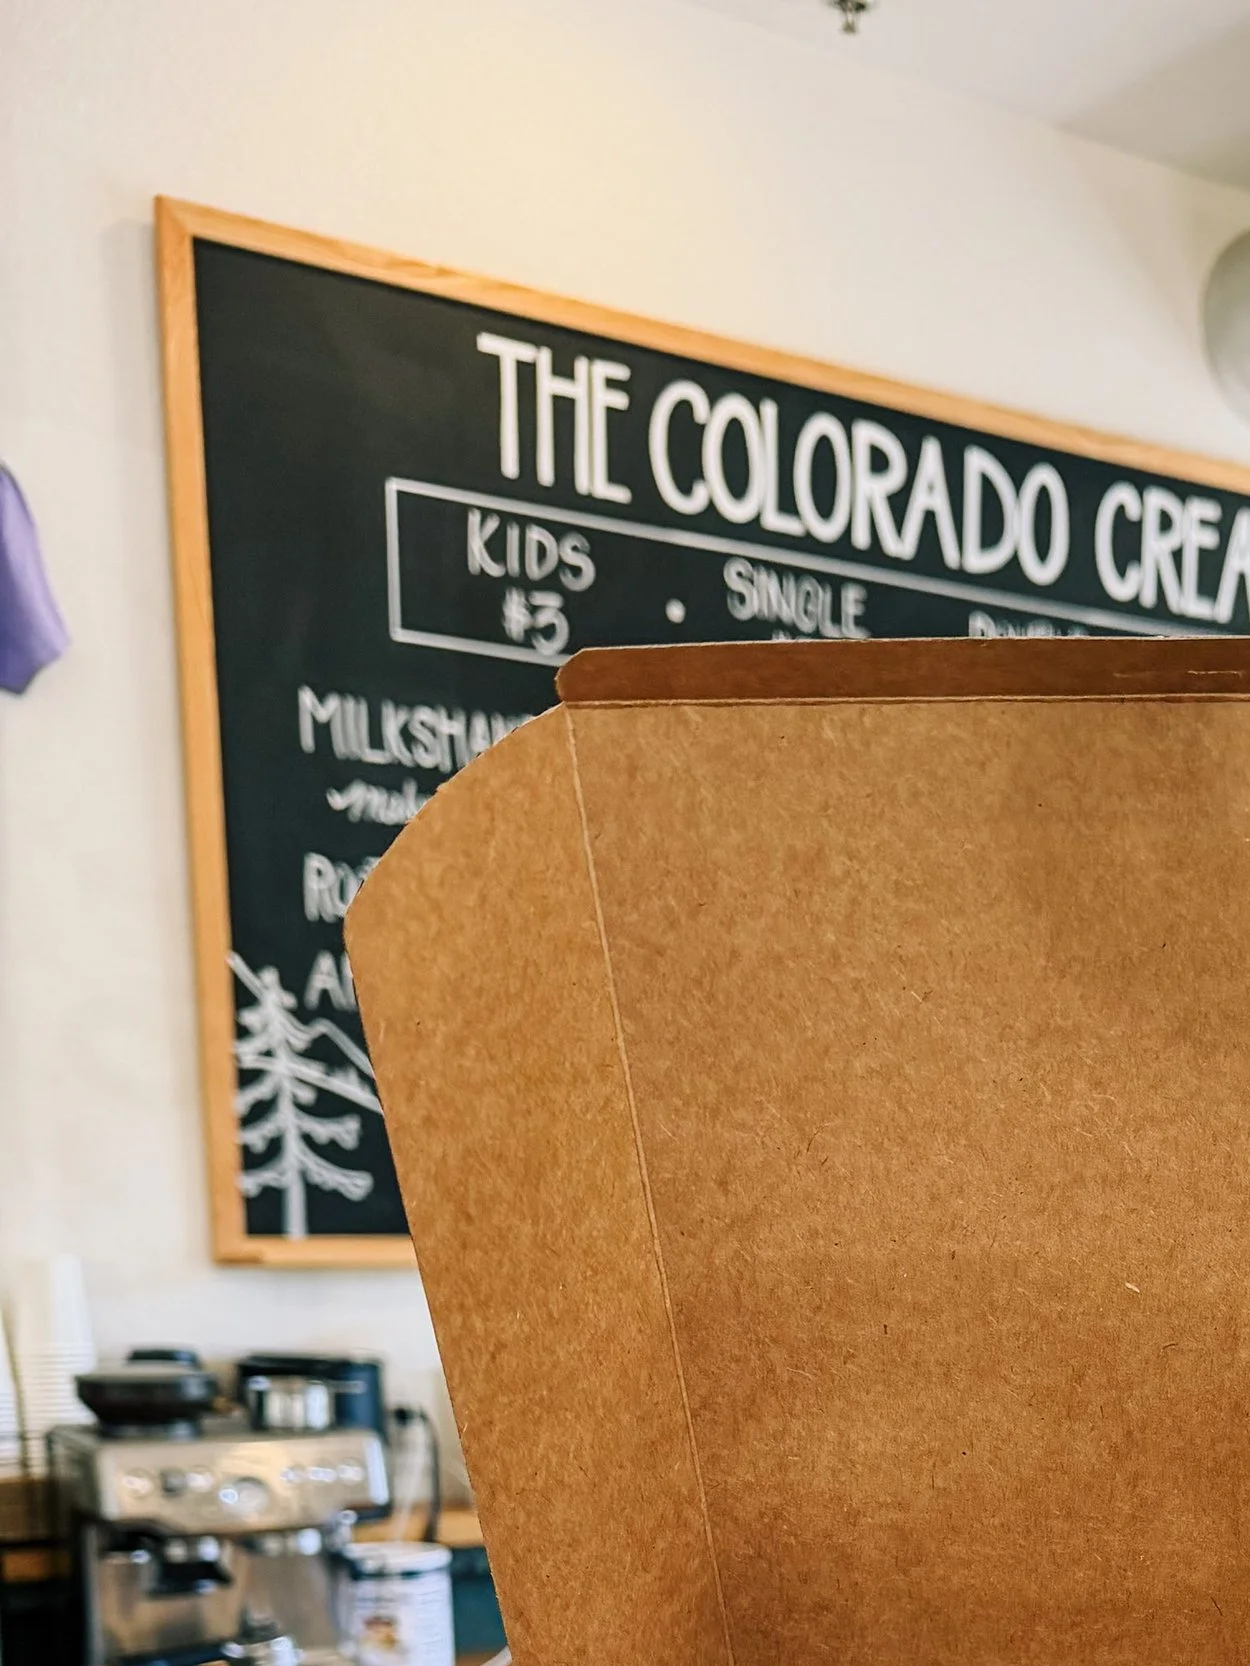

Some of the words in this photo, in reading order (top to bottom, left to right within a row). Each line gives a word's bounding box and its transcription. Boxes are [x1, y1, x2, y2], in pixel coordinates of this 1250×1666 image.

[476, 332, 632, 504] THE
[647, 380, 1070, 587] COLORADO
[466, 508, 596, 592] KIDS
[501, 588, 571, 656] $3
[723, 556, 872, 640] SINGLE
